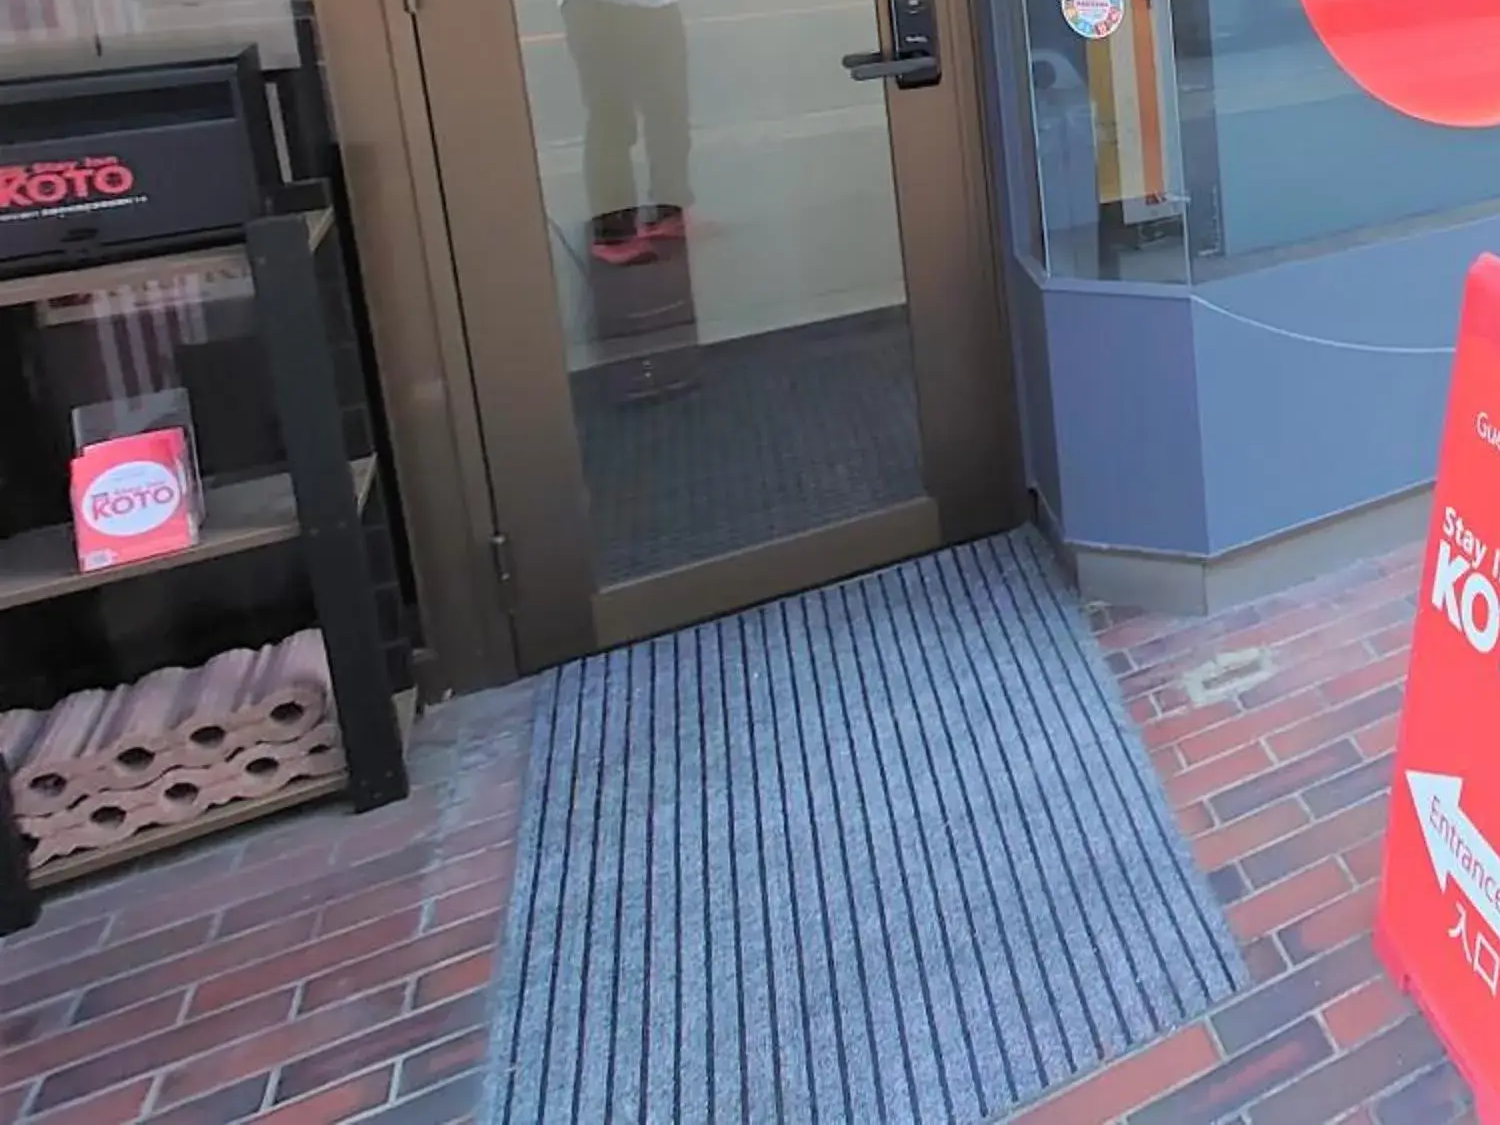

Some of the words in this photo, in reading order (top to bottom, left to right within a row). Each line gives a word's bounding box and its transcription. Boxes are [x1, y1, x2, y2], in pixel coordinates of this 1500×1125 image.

[0, 164, 134, 207] KOTO
[91, 486, 174, 521] KOTO
[1443, 506, 1487, 568] Stay
[1448, 902, 1500, 998] 入口
